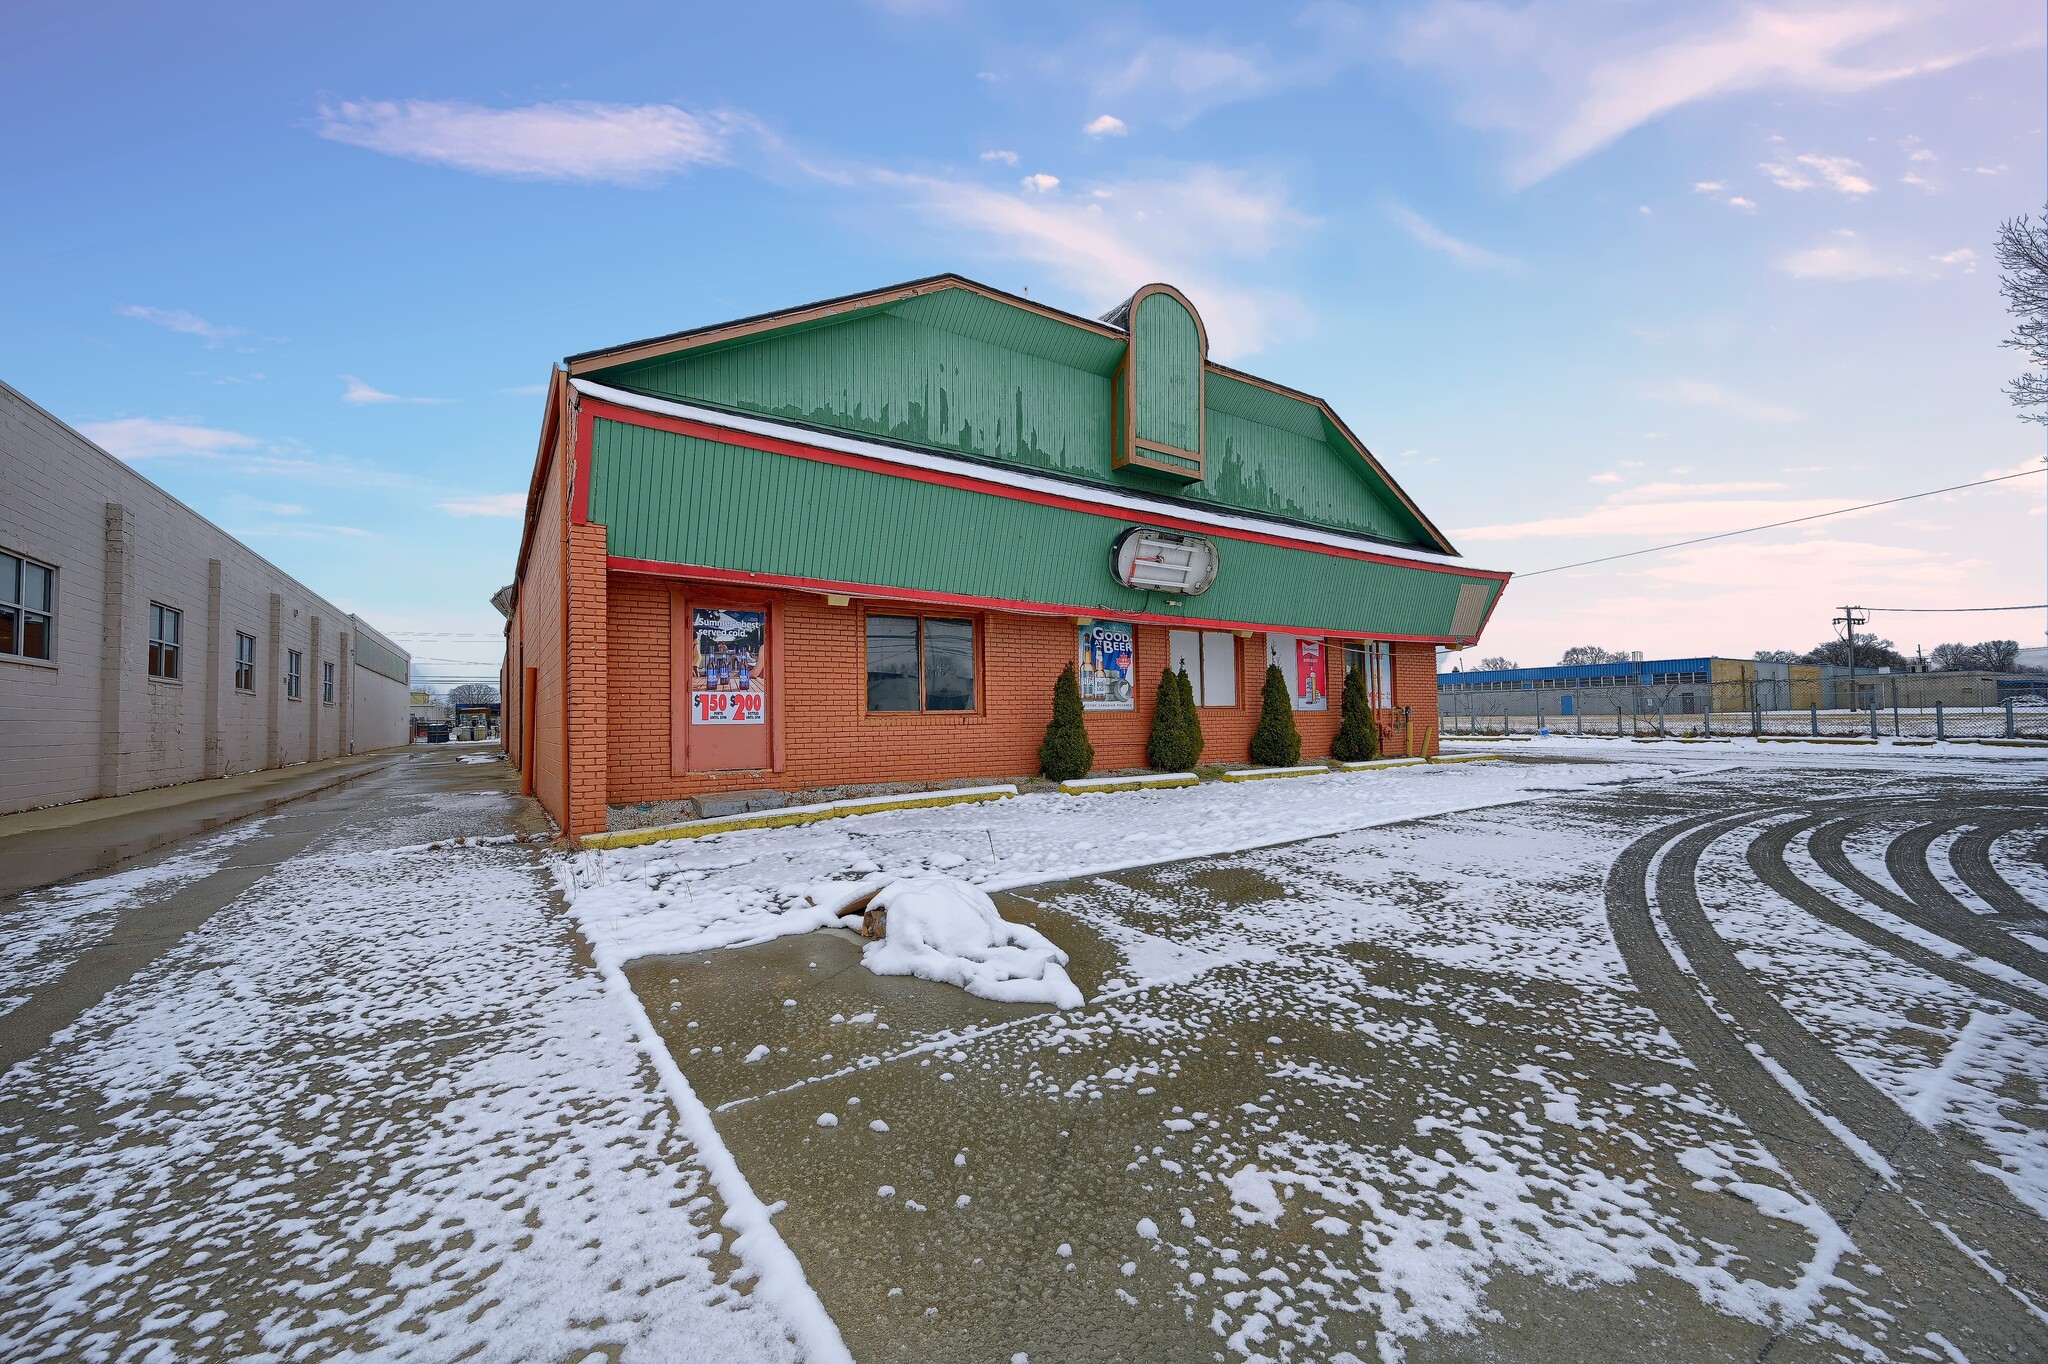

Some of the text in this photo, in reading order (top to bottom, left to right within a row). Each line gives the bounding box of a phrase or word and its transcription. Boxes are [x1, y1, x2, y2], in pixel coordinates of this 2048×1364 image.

[699, 618, 741, 628] Summer's
[741, 620, 759, 629] best
[698, 629, 727, 637] served
[1103, 641, 1132, 653] BEER
